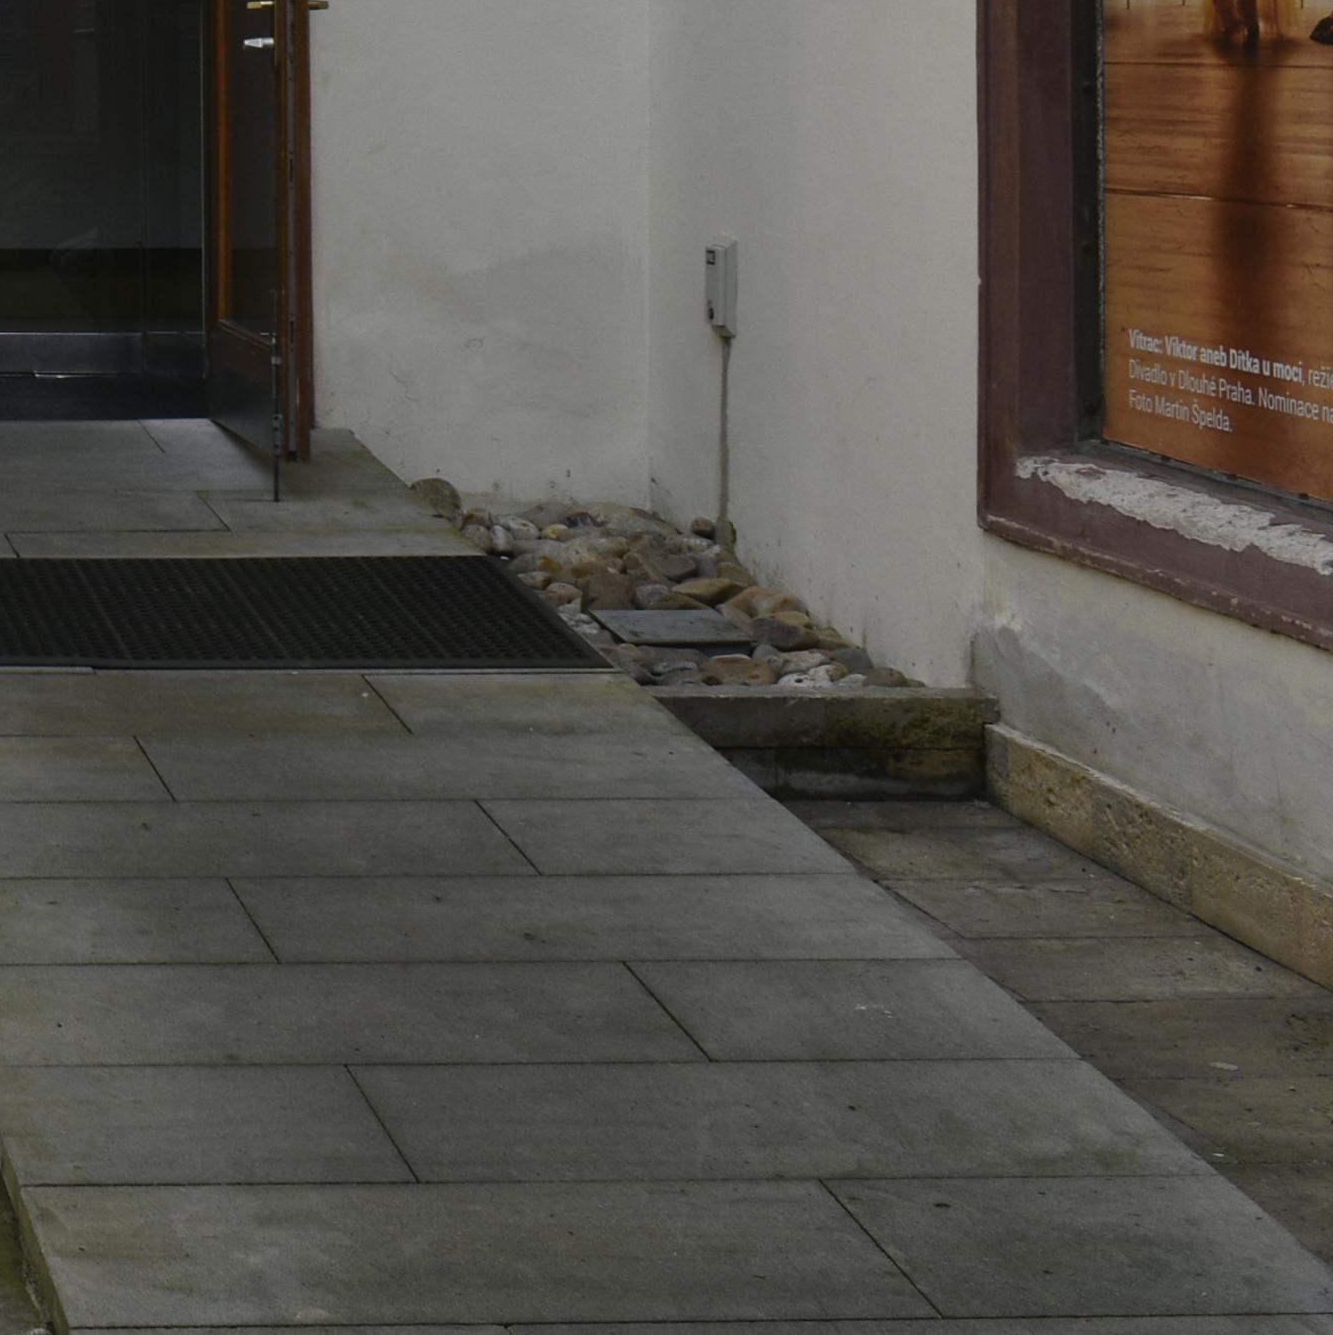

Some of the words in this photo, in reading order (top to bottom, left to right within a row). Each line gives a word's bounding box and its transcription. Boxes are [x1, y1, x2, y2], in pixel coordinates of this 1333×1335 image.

[1128, 328, 1163, 354] Vitrac:
[1165, 335, 1198, 361] Viktor
[1200, 345, 1227, 367] aneb
[1262, 359, 1271, 376] u
[1273, 360, 1305, 386] moci,
[1129, 358, 1168, 386] Divadlo
[1169, 371, 1176, 387] v
[1178, 369, 1217, 397] Dlouhé
[1219, 378, 1255, 406] Praha.
[1258, 386, 1319, 421] Nominace
[1129, 389, 1153, 413] Foto
[1155, 394, 1190, 422] Martin
[1192, 398, 1233, 432] Špelda.
